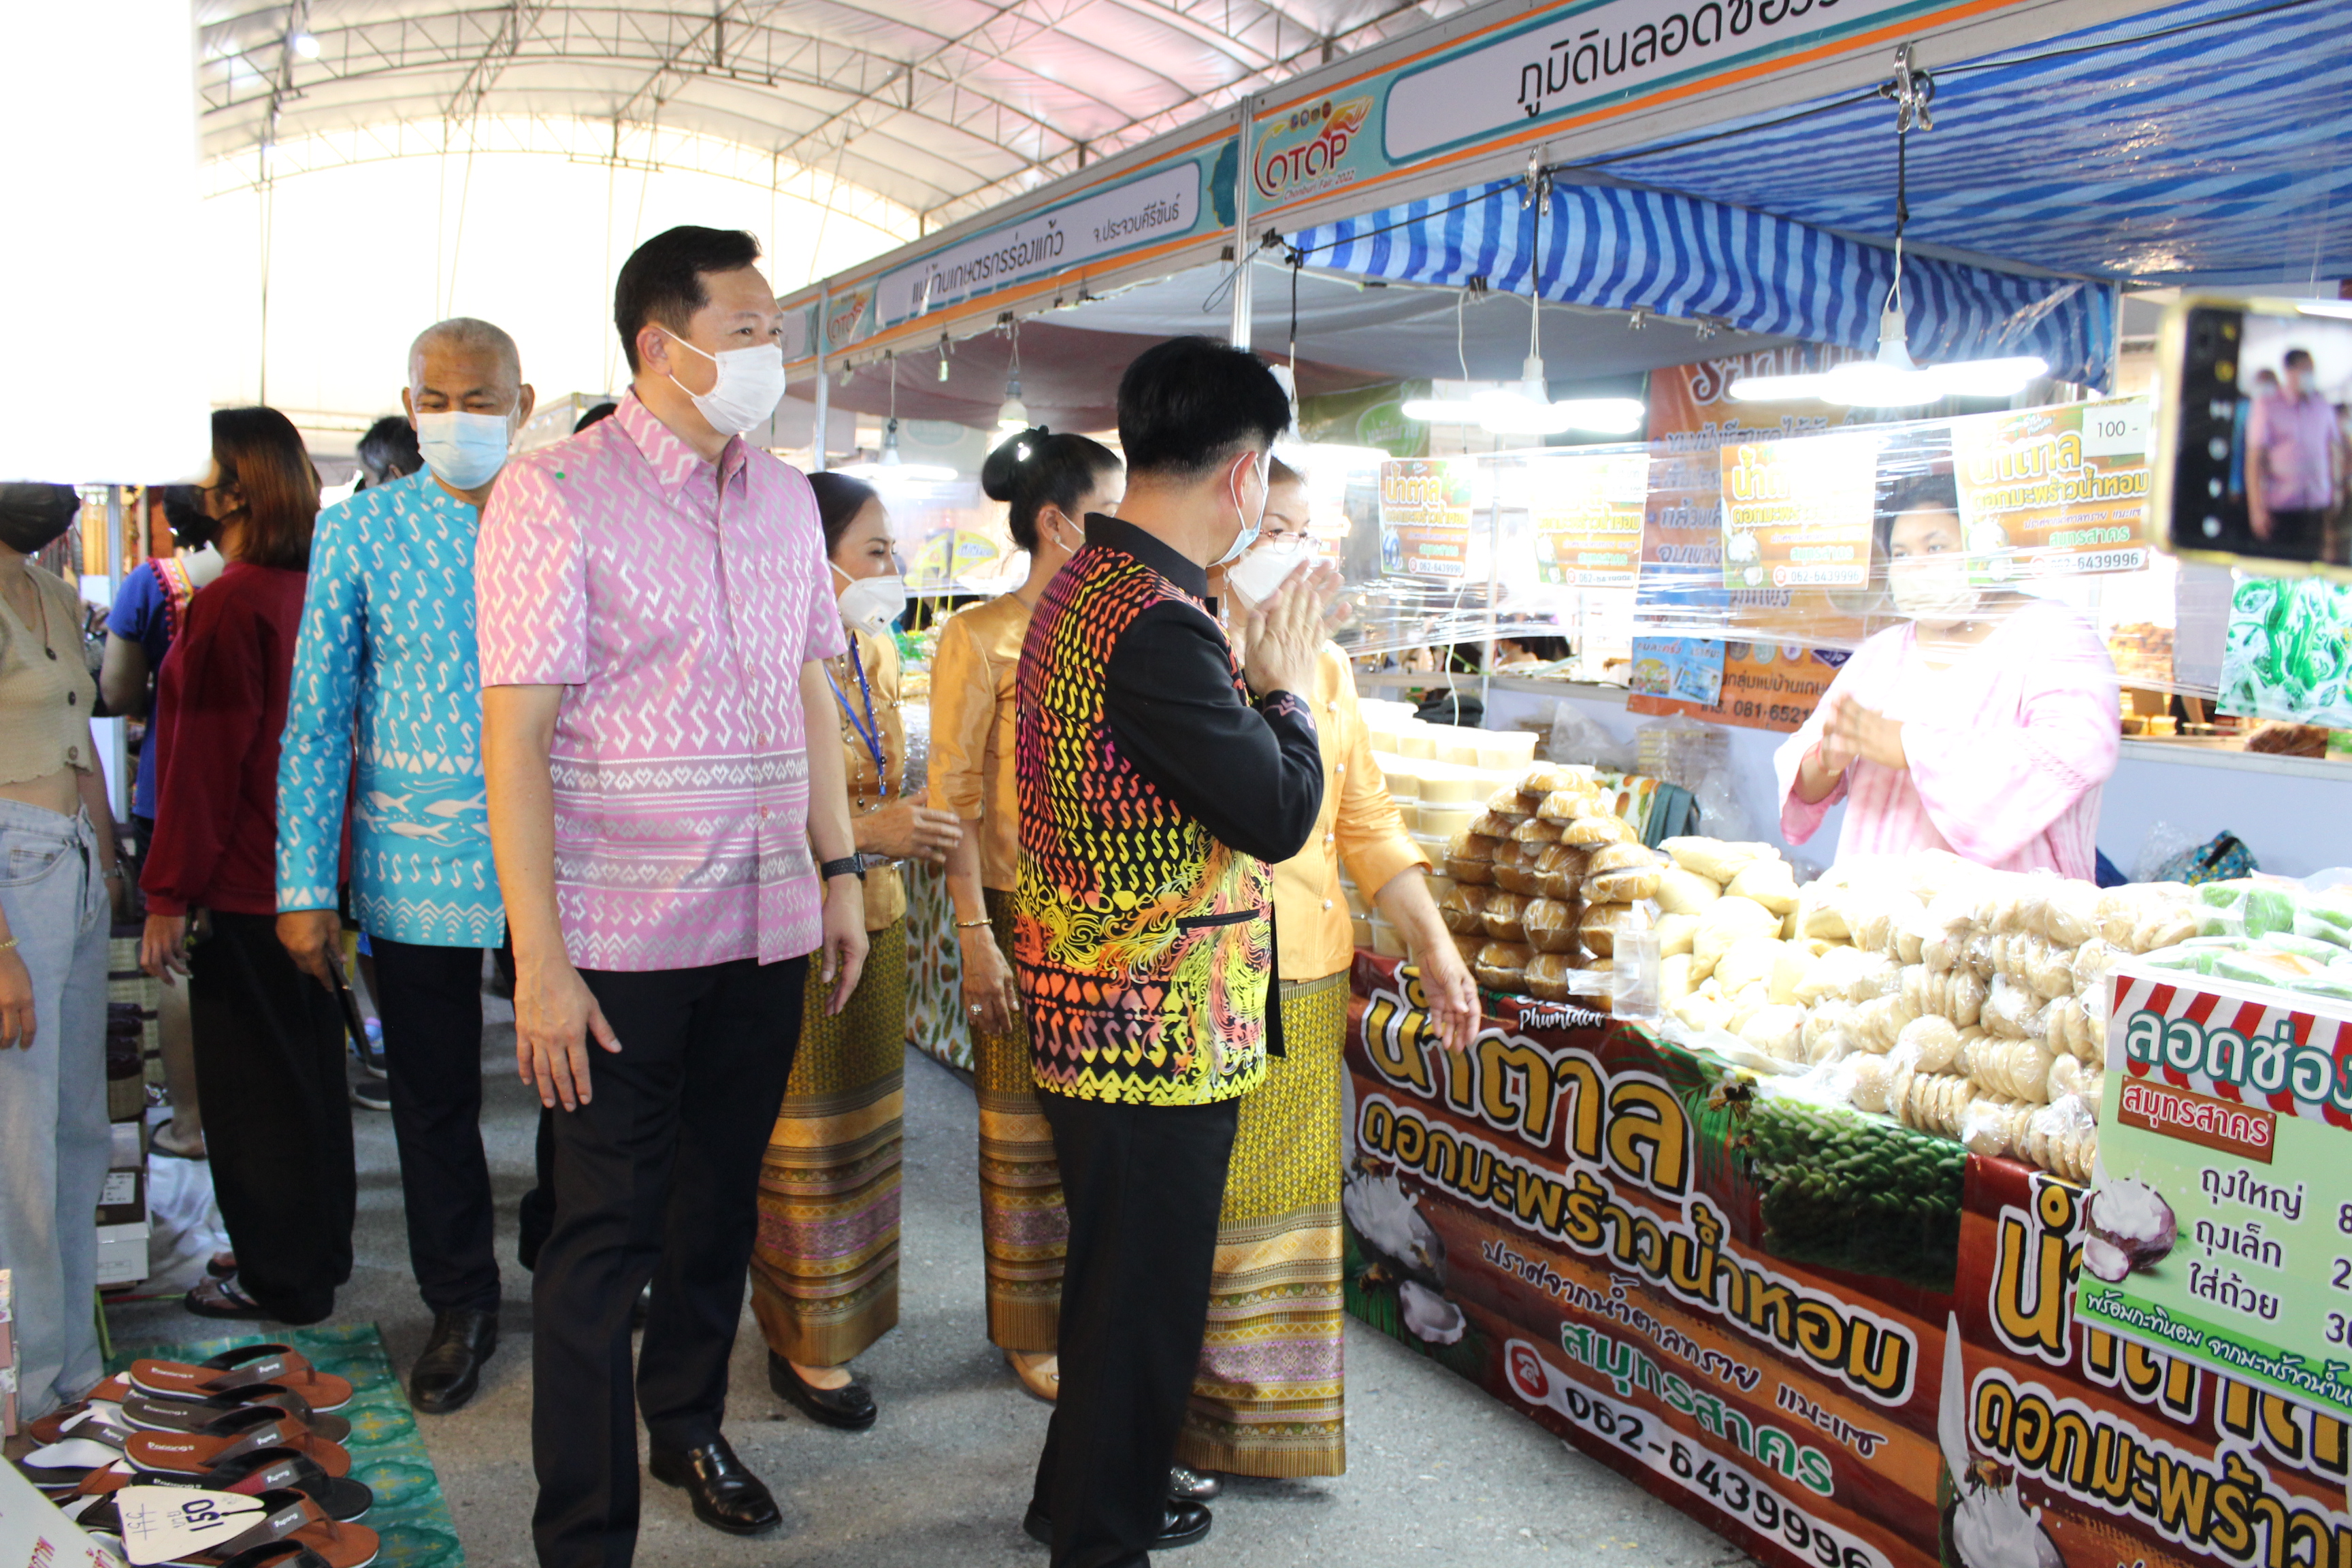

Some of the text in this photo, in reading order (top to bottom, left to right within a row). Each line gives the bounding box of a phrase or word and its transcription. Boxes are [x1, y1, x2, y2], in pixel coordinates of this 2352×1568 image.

[1266, 133, 1348, 189] OTOP
[1335, 170, 1355, 186] 2022
[1093, 191, 1181, 244] จ.ประจวบคีรีขันธ์
[2097, 420, 2125, 438] 100
[2049, 526, 2130, 549] สมุทรสาคร
[1791, 570, 1860, 582] 062-6439996
[2123, 1085, 2270, 1147] สมุทรสาคร
[2201, 1169, 2304, 1220] ถุงใหญ่
[1363, 1102, 1911, 1399] ดอกมะพร้าวน้ำหอม
[2195, 1221, 2283, 1268] ถุงเล็ก
[2189, 1262, 2278, 1320] ใส่ถ้วย
[2086, 1290, 2204, 1347] พร้อมกะทิหอม
[1561, 1322, 1835, 1497] สมุทรสาคร
[182, 1499, 225, 1532] 150
